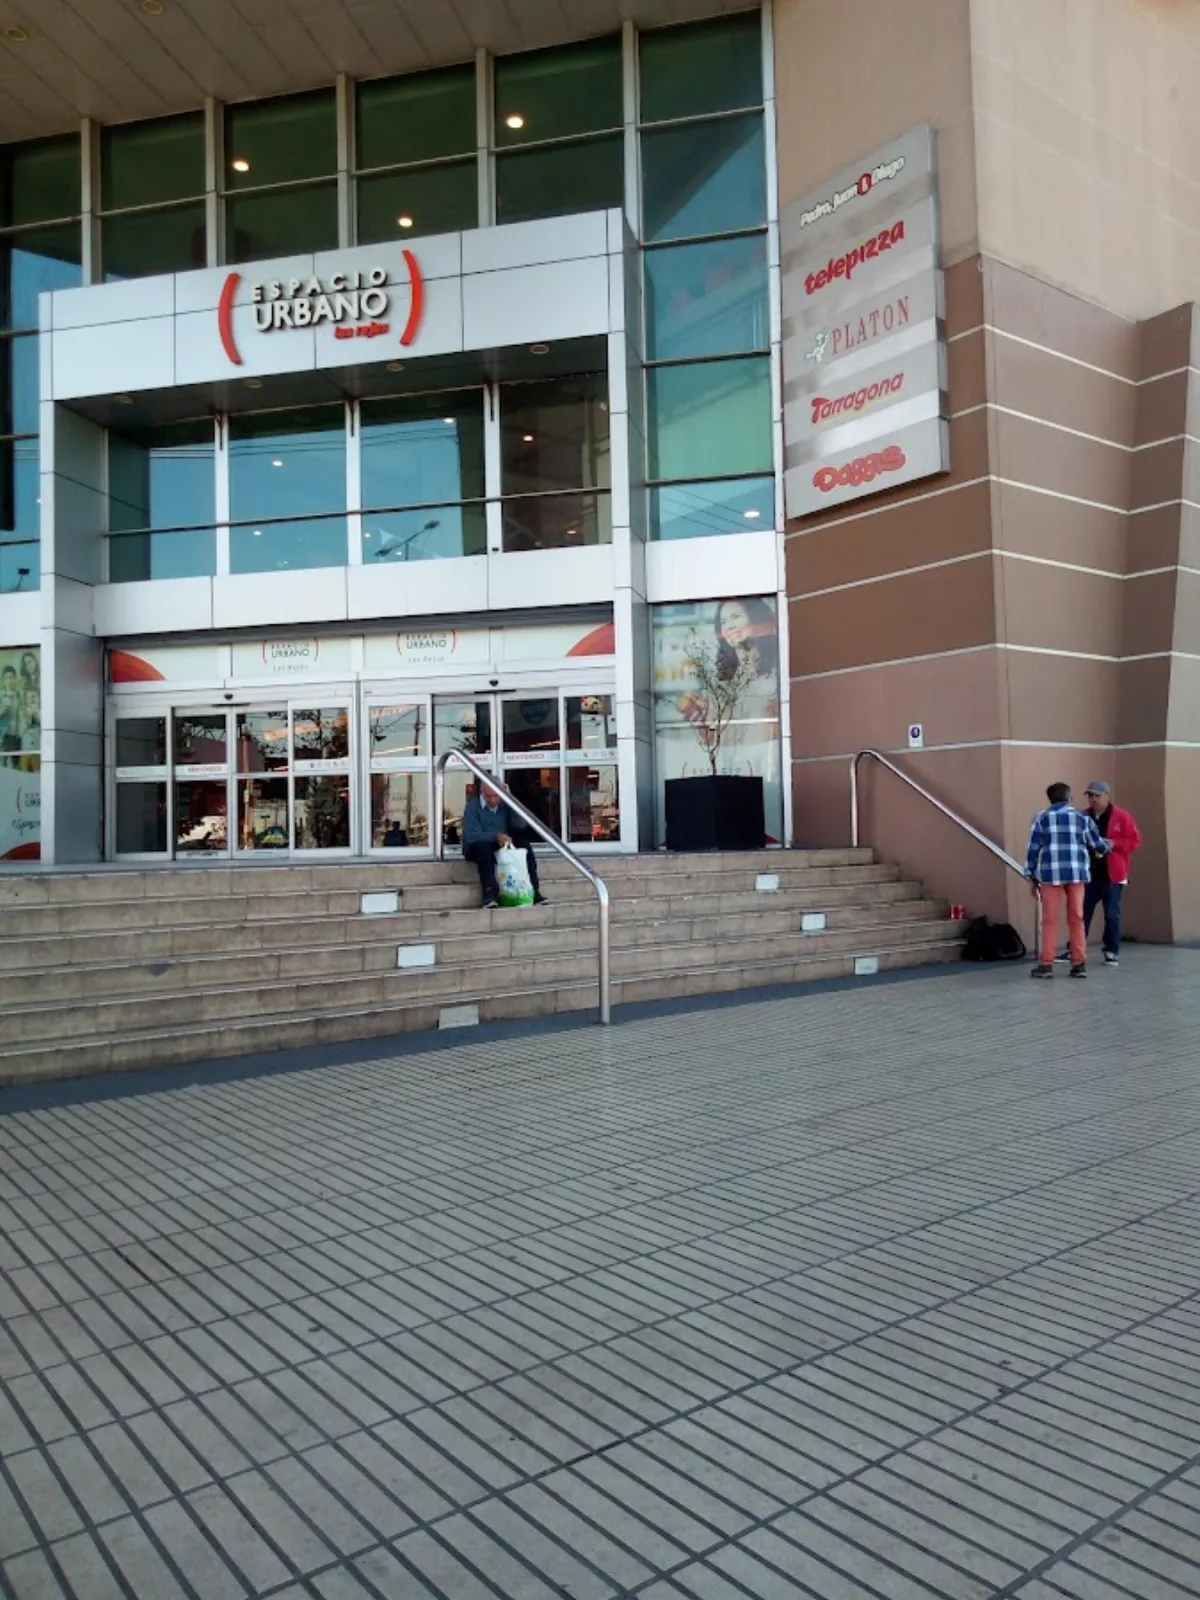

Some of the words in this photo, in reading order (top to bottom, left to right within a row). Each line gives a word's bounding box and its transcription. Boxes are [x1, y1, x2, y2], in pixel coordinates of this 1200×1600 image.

[804, 220, 904, 296] telepizza
[252, 266, 388, 302] ESPACIO
[252, 287, 389, 332] URBANO
[832, 295, 910, 356] PLATON
[811, 372, 904, 424] Tarragona
[271, 648, 310, 658] URBANO
[406, 639, 447, 650] URBANO
